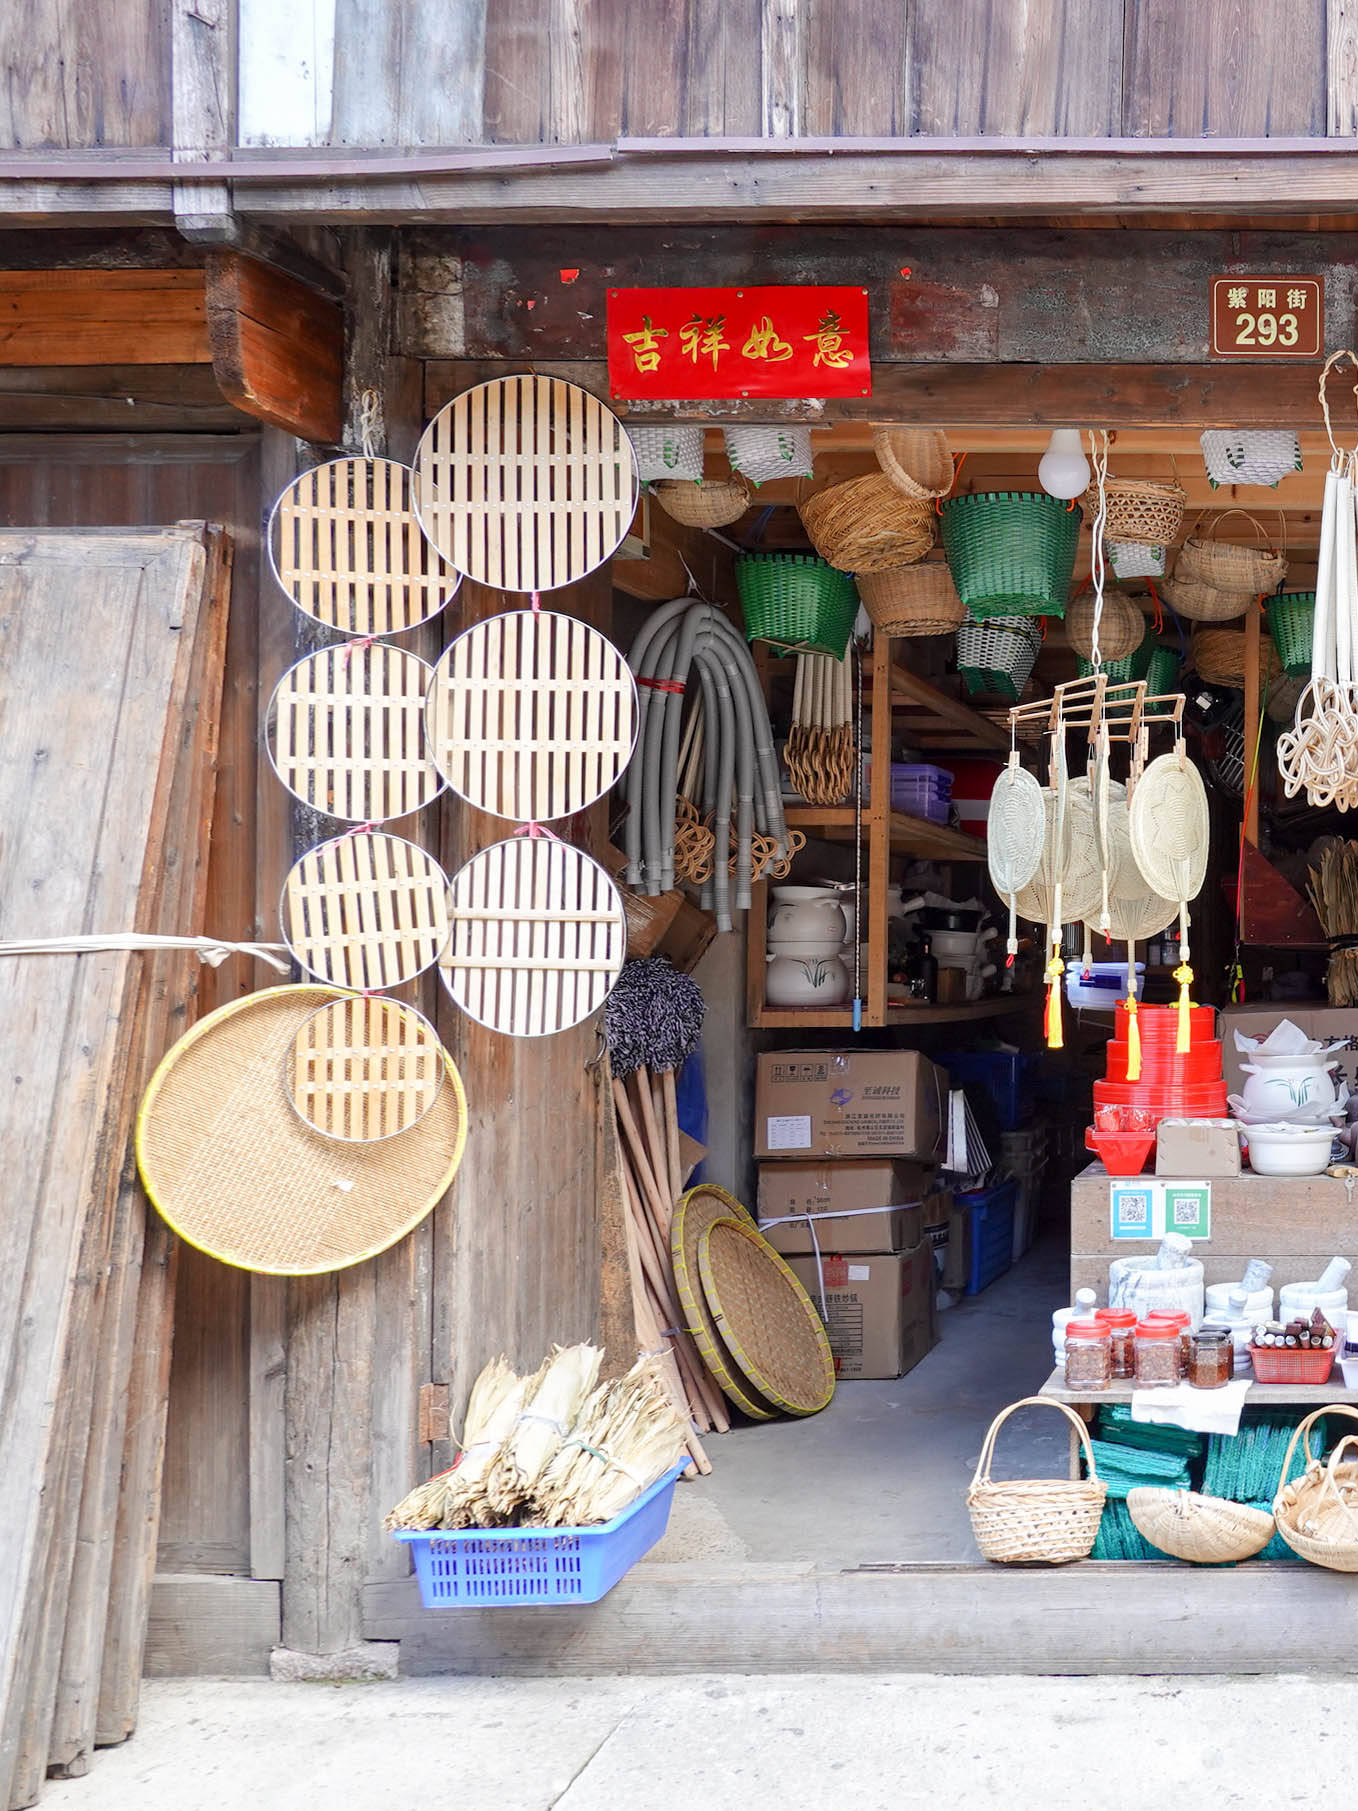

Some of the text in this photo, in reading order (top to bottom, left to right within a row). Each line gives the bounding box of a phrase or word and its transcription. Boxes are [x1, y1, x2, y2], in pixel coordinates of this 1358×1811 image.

[1227, 286, 1308, 310] 紫阳街
[621, 308, 856, 374] 吉祥如意
[1235, 313, 1300, 346] 293
